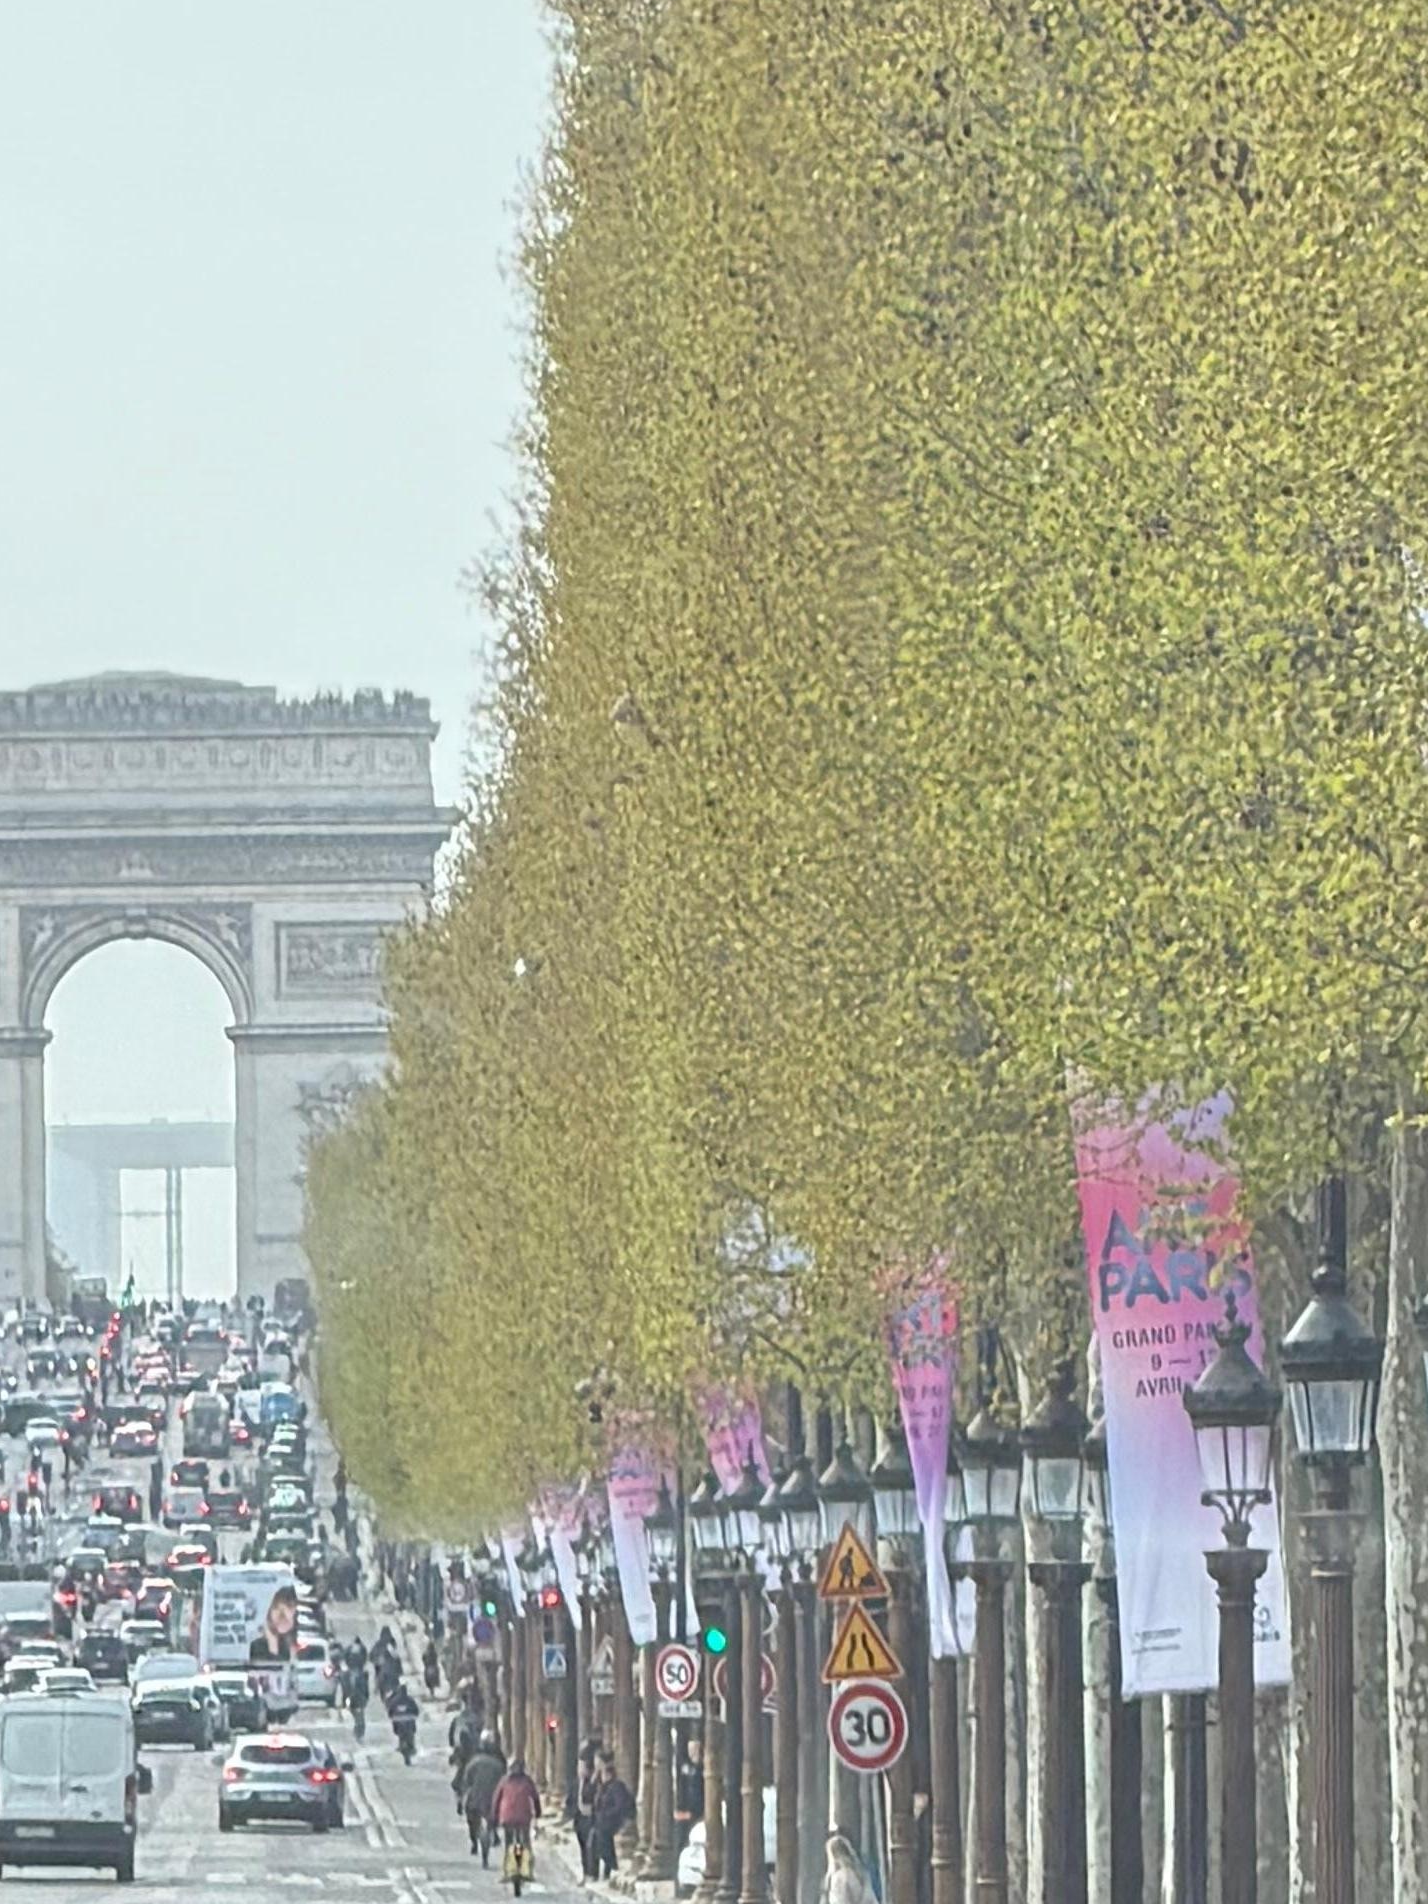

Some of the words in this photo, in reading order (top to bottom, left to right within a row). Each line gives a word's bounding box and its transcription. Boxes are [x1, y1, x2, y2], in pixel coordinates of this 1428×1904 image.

[1112, 1324, 1176, 1349] GRAND
[665, 1663, 688, 1684] 50
[845, 1706, 891, 1746] 30
